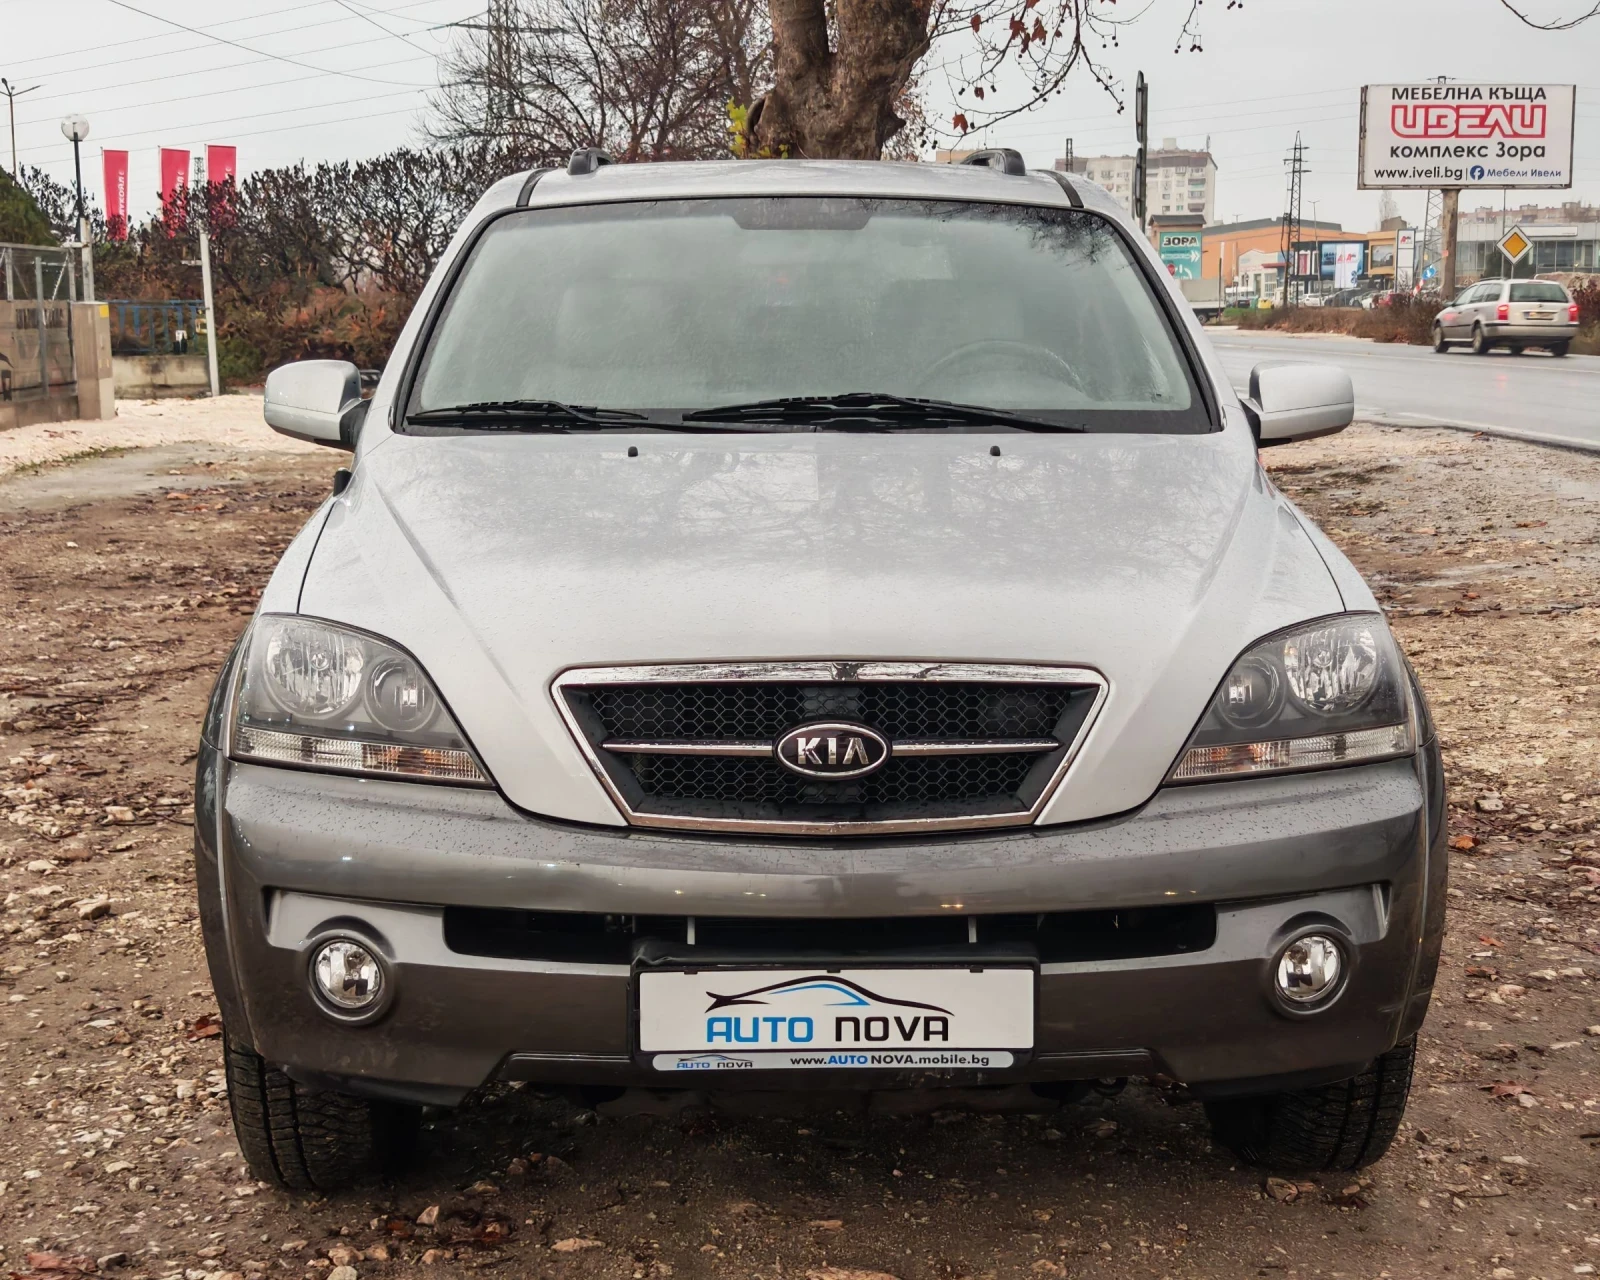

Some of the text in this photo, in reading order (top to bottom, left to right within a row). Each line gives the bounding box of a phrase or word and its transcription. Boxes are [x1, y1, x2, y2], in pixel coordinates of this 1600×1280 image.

[1392, 87, 1547, 103] МЕБЕЛНА КЪЩА
[1390, 104, 1547, 139] ИВЕЛИ
[1390, 141, 1546, 161] комплекс Зора
[1374, 166, 1463, 181] www.iveli.bg
[1486, 167, 1562, 178] Мебели Ивели
[1163, 236, 1199, 247] ЗОРА
[796, 736, 870, 765] KIA
[706, 1016, 949, 1043] AUTO NOVA
[676, 1061, 754, 1069] AUTO NOVA
